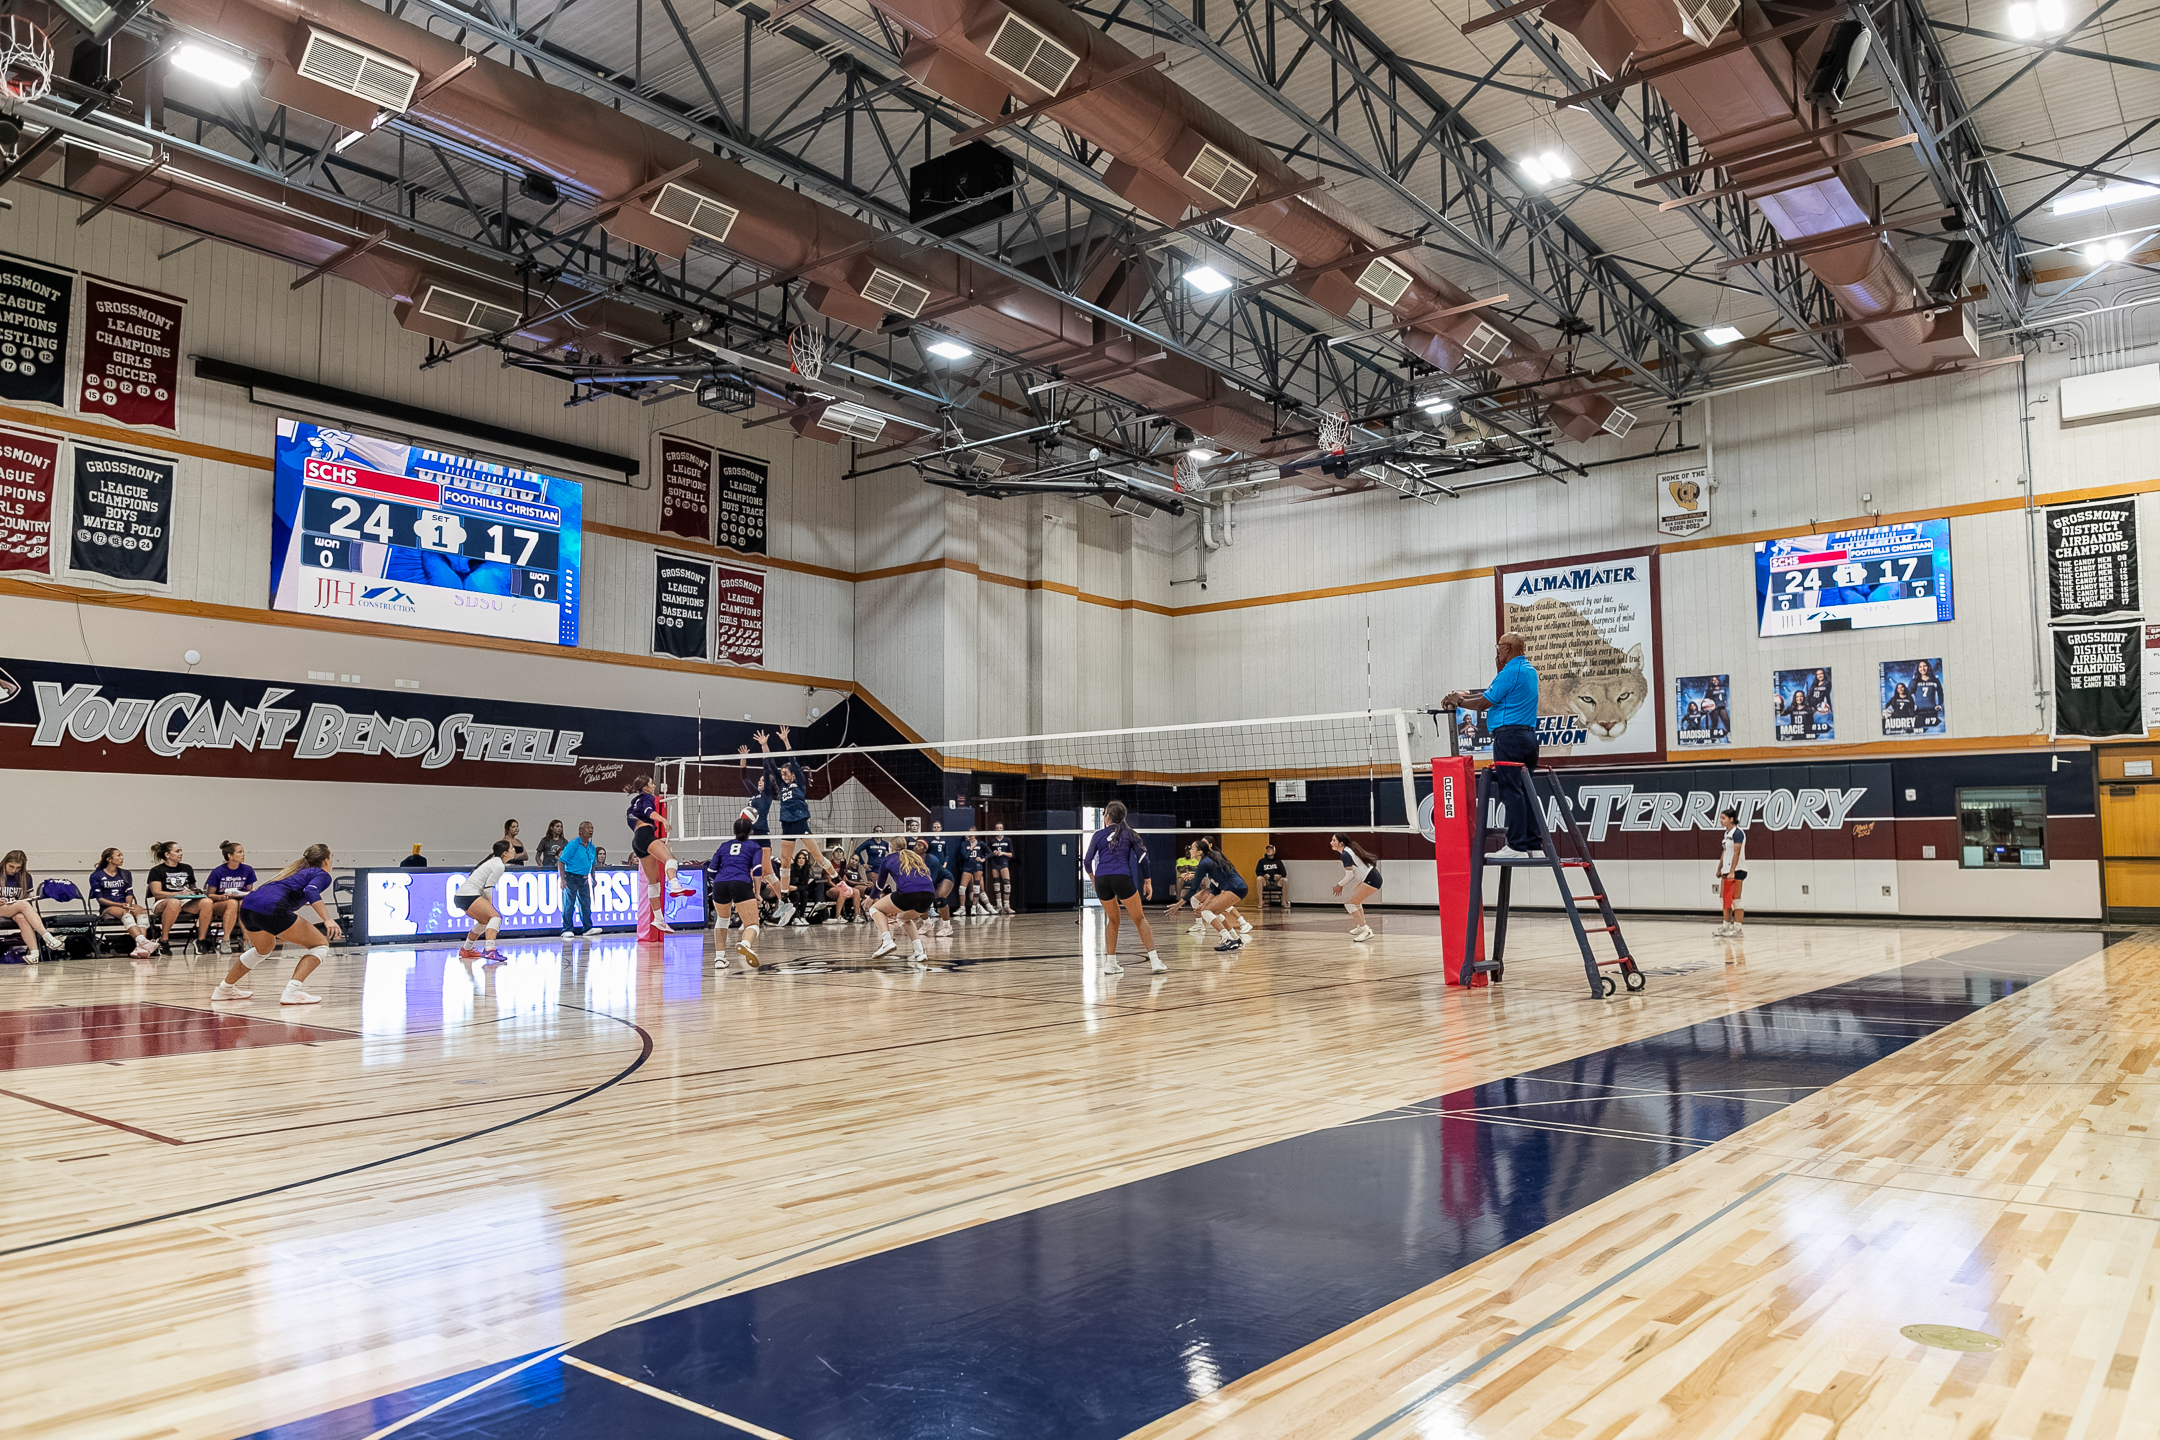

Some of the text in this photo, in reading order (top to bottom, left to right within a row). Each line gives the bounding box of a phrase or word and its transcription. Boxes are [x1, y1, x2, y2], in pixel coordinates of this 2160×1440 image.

[96, 301, 174, 330] GROSSMONT
[107, 318, 161, 341] LEAGUE
[96, 330, 171, 358] CHAMPIONS
[4, 345, 14, 354] 10
[42, 353, 51, 361] 12
[113, 351, 152, 369] GIRLS
[4, 361, 14, 370] 17
[106, 364, 157, 384] SOCCER
[88, 391, 97, 399] 15
[89, 376, 98, 384] 10
[122, 383, 131, 391] 12
[139, 387, 148, 395] 13
[157, 391, 165, 399] 14
[665, 452, 709, 471] GROSSMONT
[86, 461, 163, 484] GROSSMONT
[673, 464, 702, 478] LEAGUE
[723, 466, 764, 485] GROSSMONT
[1662, 474, 1680, 482] HOME
[100, 480, 149, 499] LEAGUE
[666, 474, 707, 491] CHAMPIONS
[729, 480, 757, 494] LEAGUE
[308, 462, 558, 522] SCHS FOOTHILLS CHRISTIAN
[668, 487, 706, 503] SOFTBALL
[723, 490, 763, 506] CHAMPIONS
[88, 491, 159, 513] CHAMPIONS
[722, 501, 764, 517] BOYS TRACK
[105, 506, 138, 522] BOYS
[432, 515, 450, 523] SET
[2053, 510, 2129, 529] GROSSMONT
[83, 514, 161, 538] WATER POLO
[330, 497, 540, 567] 24 17
[2061, 521, 2120, 536] DISTRICT
[432, 525, 448, 549] 1
[2060, 531, 2123, 547] AIRBANDS
[141, 541, 150, 549] 24
[2055, 541, 2129, 558] CHAMPIONS
[320, 550, 333, 568] 0
[1772, 541, 1932, 567] SCHS FOOTHILLS CHRISTIAN
[1785, 557, 1919, 593] 24 17
[2074, 564, 2096, 572] CANDY
[2098, 568, 2112, 576] MEN
[661, 568, 706, 585] GROSSMONT
[1514, 566, 1638, 598] ALMA MATER
[1845, 572, 1855, 584] 1
[2075, 577, 2097, 585] CANDY
[314, 577, 356, 608] JJH
[534, 583, 545, 599] 0
[667, 582, 698, 595] LEAGUE
[720, 578, 762, 595] GROSSMONT
[1915, 587, 1925, 597] 0
[2076, 583, 2097, 591] CANDY
[2077, 589, 2098, 597] CANDY
[661, 593, 705, 608] CHAMPIONS
[727, 592, 754, 605] LEAGUE
[2061, 602, 2081, 610] TOXIC
[2083, 600, 2107, 609] CANDY
[2077, 595, 2098, 603] CANDY
[358, 600, 416, 613] CONSTRUCTION
[662, 606, 703, 620] BASEBALL
[720, 602, 761, 617] CHAMPIONS
[719, 614, 762, 629] GIRLS TRACK
[2067, 632, 2128, 645] GROSSMONT
[2073, 644, 2121, 655] DISTRICT
[2072, 653, 2122, 665] AIRBANDS
[2070, 663, 2125, 675] CHAMPIONS
[1922, 687, 1929, 697] 7
[1794, 715, 1803, 724] 10
[1885, 717, 1916, 728] AUDREY
[1680, 729, 1711, 739] MADISON
[1780, 724, 1804, 734] MACIE
[601, 771, 617, 781] 2004
[1444, 777, 1453, 817] PORTER
[1577, 783, 1868, 842] TERRITORY
[729, 843, 742, 856] 8
[877, 849, 883, 858] 7
[103, 879, 125, 889] KNIGHTS
[111, 889, 120, 897] 2
[505, 913, 639, 925] CANYON SCHOOL
